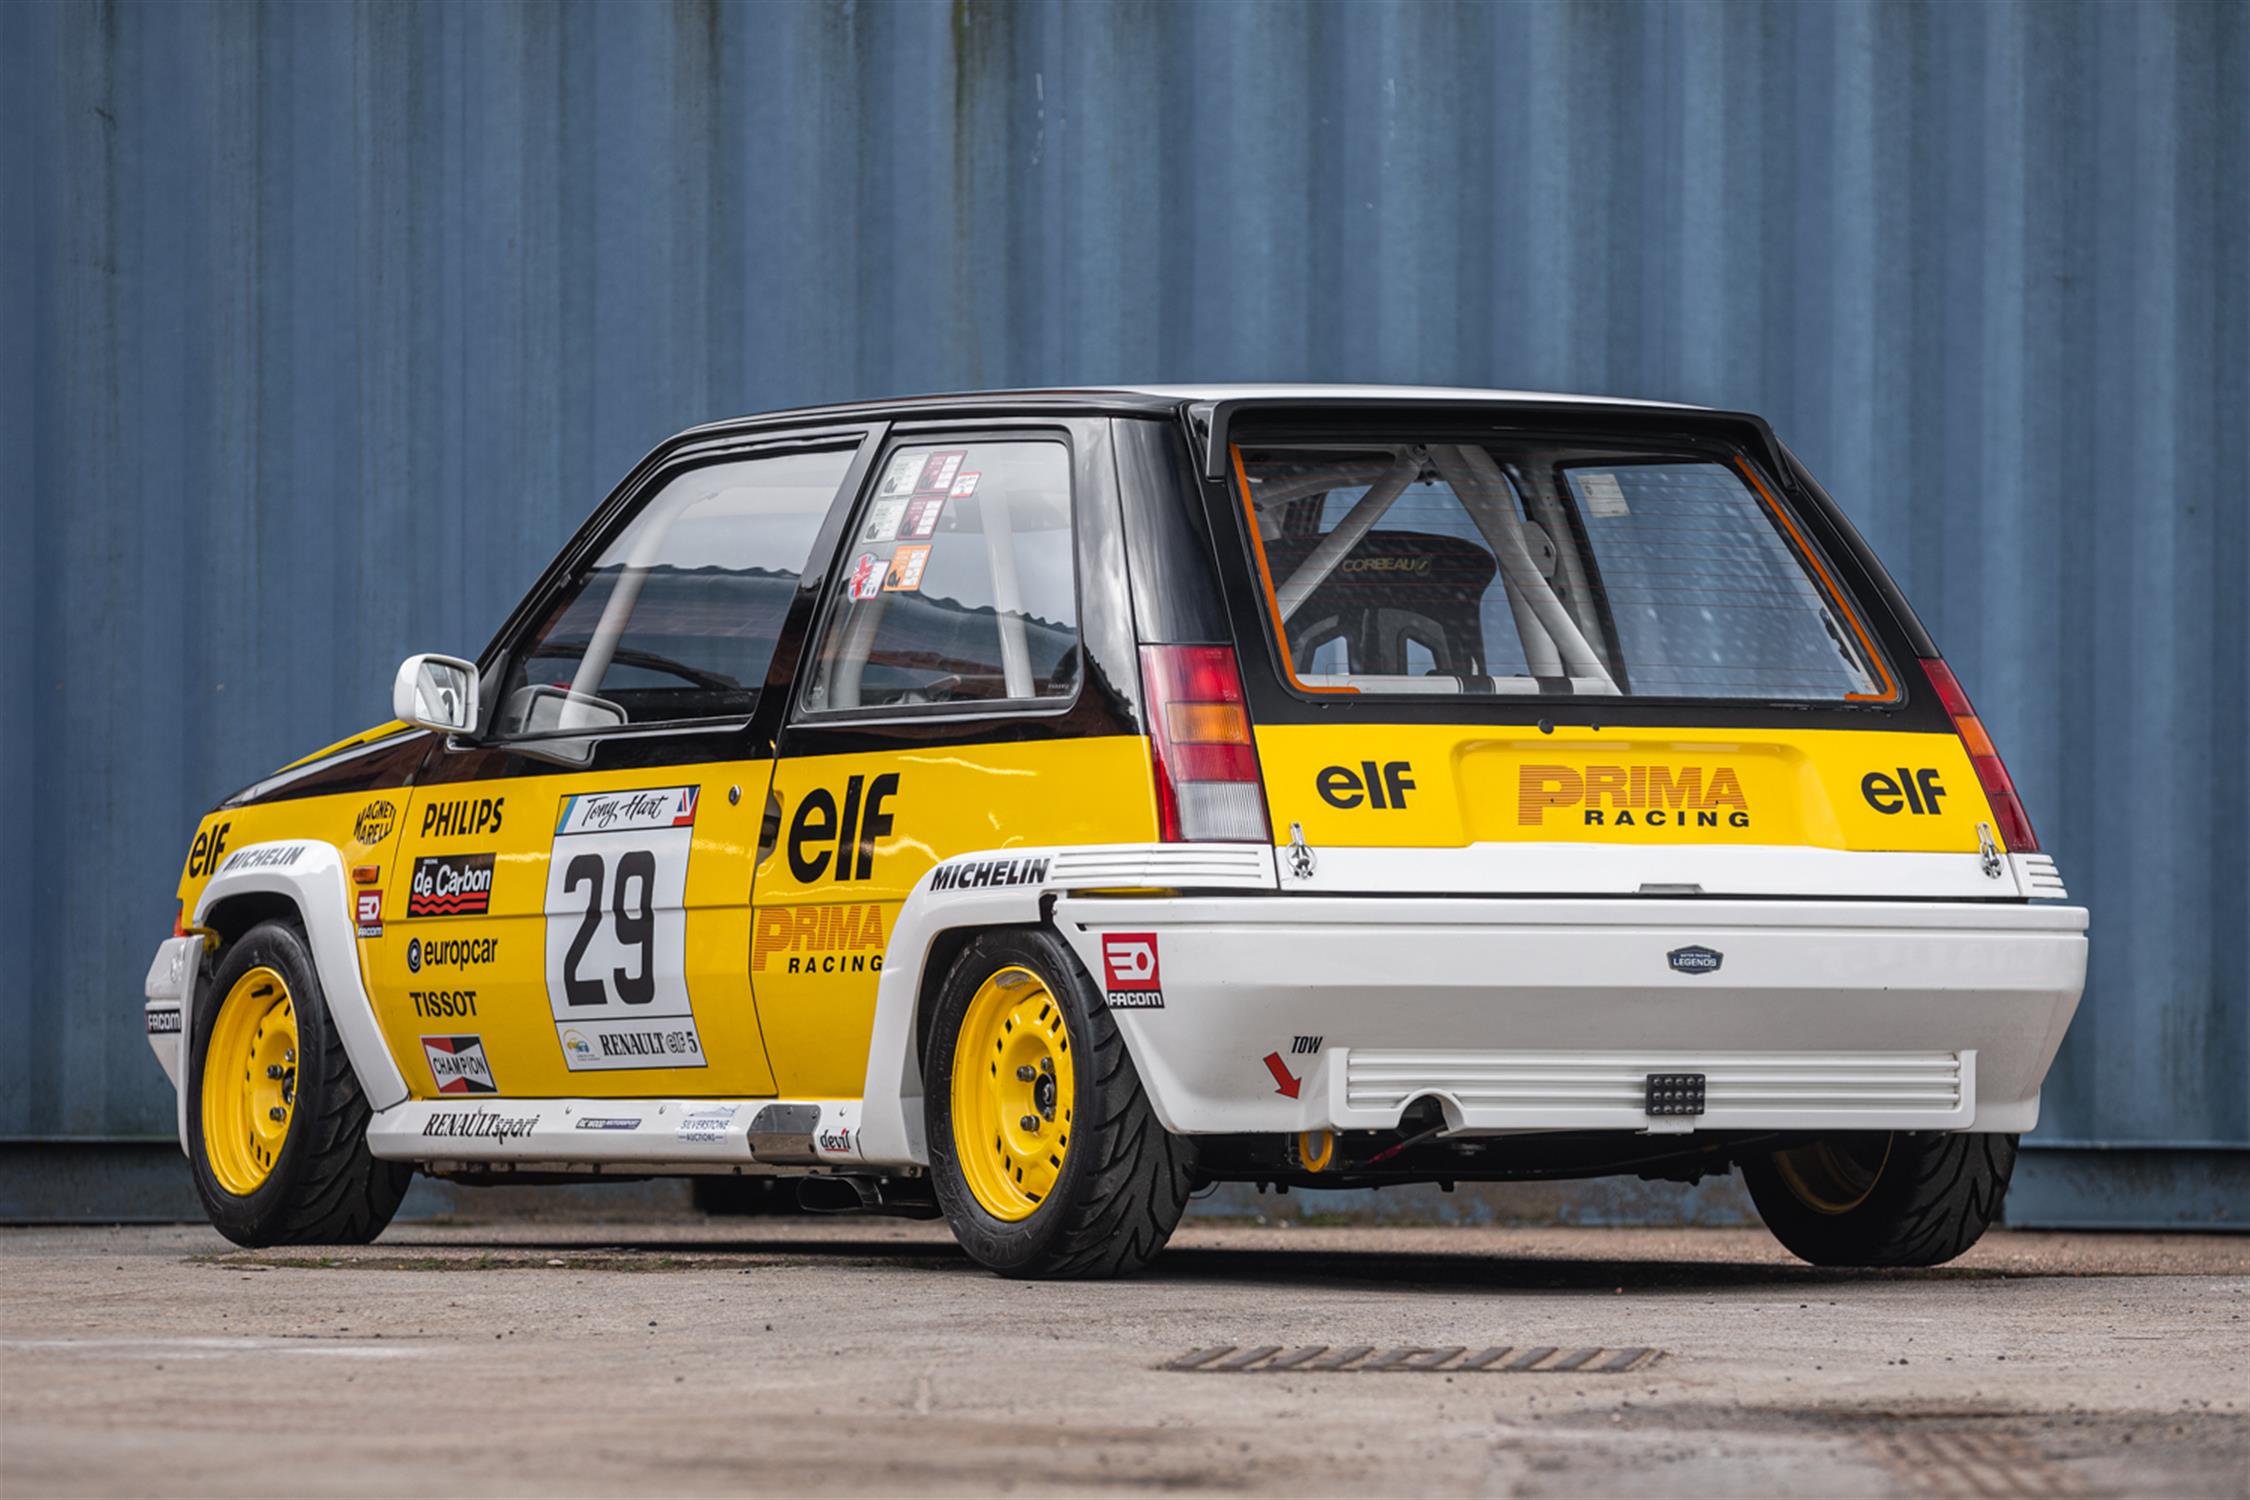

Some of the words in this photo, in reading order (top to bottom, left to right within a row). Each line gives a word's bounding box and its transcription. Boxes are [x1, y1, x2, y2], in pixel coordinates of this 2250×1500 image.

[1342, 558, 1416, 573] CORBEAU
[1316, 761, 1417, 809] elf
[1518, 764, 1748, 826] PRIMA
[1861, 768, 1946, 815] elf
[421, 797, 504, 838] PHILIPS
[581, 796, 620, 828] Tony
[619, 793, 668, 821] Hart
[1585, 810, 1750, 828] RACING
[789, 773, 898, 884] elf
[189, 822, 231, 878] elf
[223, 846, 306, 872] MICHELIN
[413, 866, 433, 898] de
[436, 864, 492, 897] Carbon
[930, 858, 1050, 891] MICHELIN
[564, 850, 656, 1007] 29
[752, 905, 884, 971] PRIMA
[424, 938, 498, 971] europcar
[788, 955, 883, 974] RACING
[1673, 958, 1717, 967] LEGENDS
[410, 991, 477, 1018] TISSOT
[1109, 992, 1162, 1006] FACOM
[148, 1012, 181, 1031] FACOM
[599, 1032, 666, 1056] RENAULT
[686, 1031, 698, 1054] 5
[1291, 1035, 1323, 1054] TOW
[433, 1052, 488, 1078] CHAMPION
[820, 1128, 851, 1149] devil
